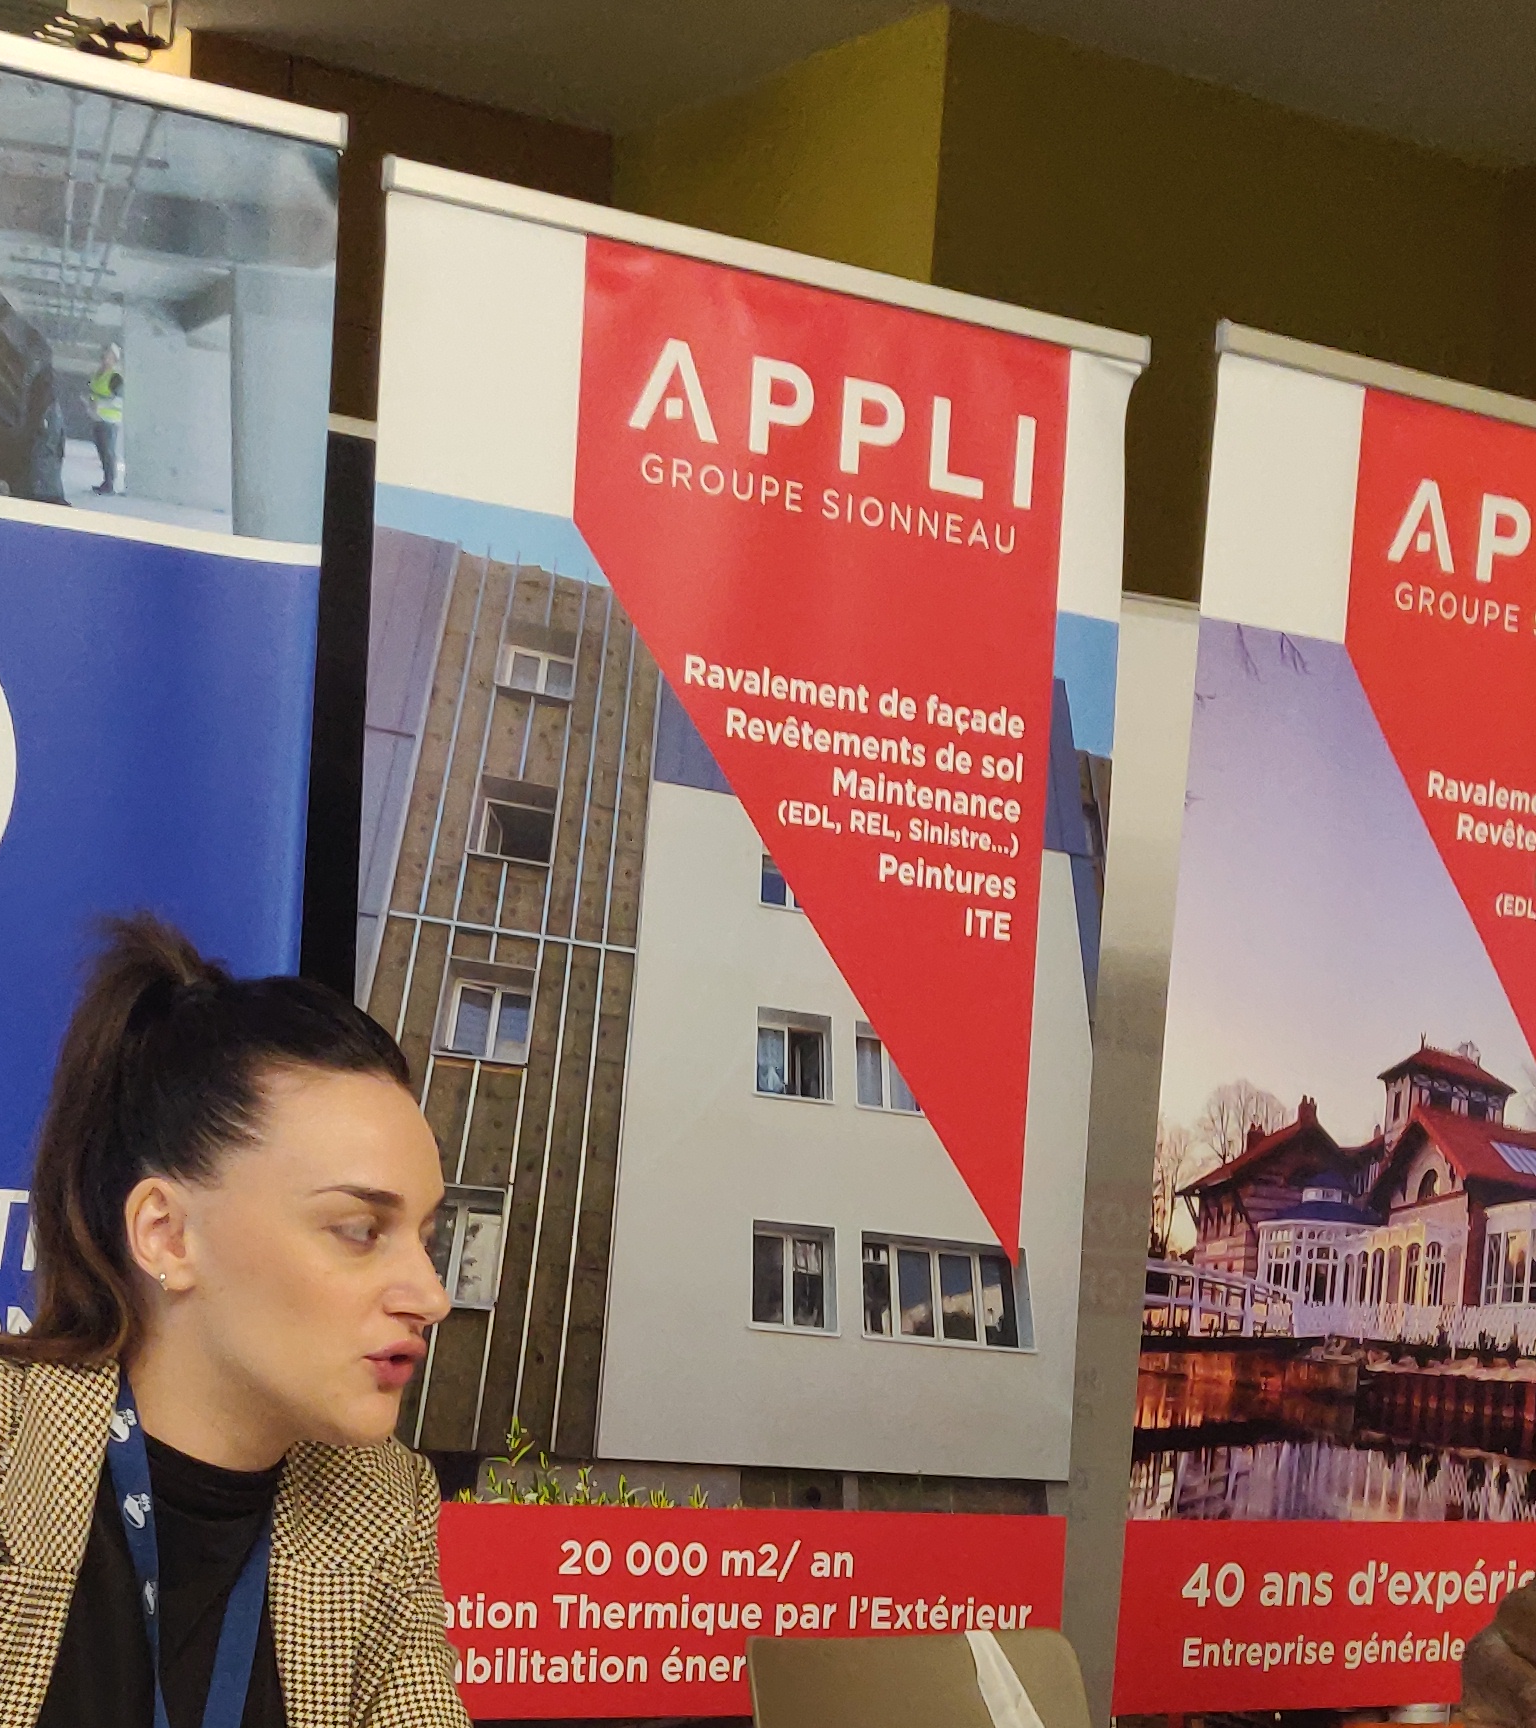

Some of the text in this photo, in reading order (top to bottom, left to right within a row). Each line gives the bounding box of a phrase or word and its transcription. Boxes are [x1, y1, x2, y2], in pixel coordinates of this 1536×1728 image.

[629, 337, 1038, 511] APPLI
[640, 453, 1017, 555] GROUPE SIONNEAU
[1394, 582, 1520, 634] GROUPE
[683, 653, 1026, 740] Ravalement de façade
[726, 706, 1024, 784] Revêtements de sol
[832, 767, 1022, 824] Maintenance
[778, 799, 1020, 858] (EDL, REL, Sinistre...)
[878, 852, 1017, 901] Peintures
[964, 906, 1012, 942] ITE
[558, 1538, 854, 1583] 20 000 m2/ an
[1181, 1562, 1245, 1608] 40
[1260, 1570, 1333, 1608] ans
[552, 1593, 763, 1636] Thermique
[774, 1602, 837, 1637] par
[848, 1594, 1033, 1631] l'Extérieur
[1181, 1631, 1466, 1672] Entreprise générale
